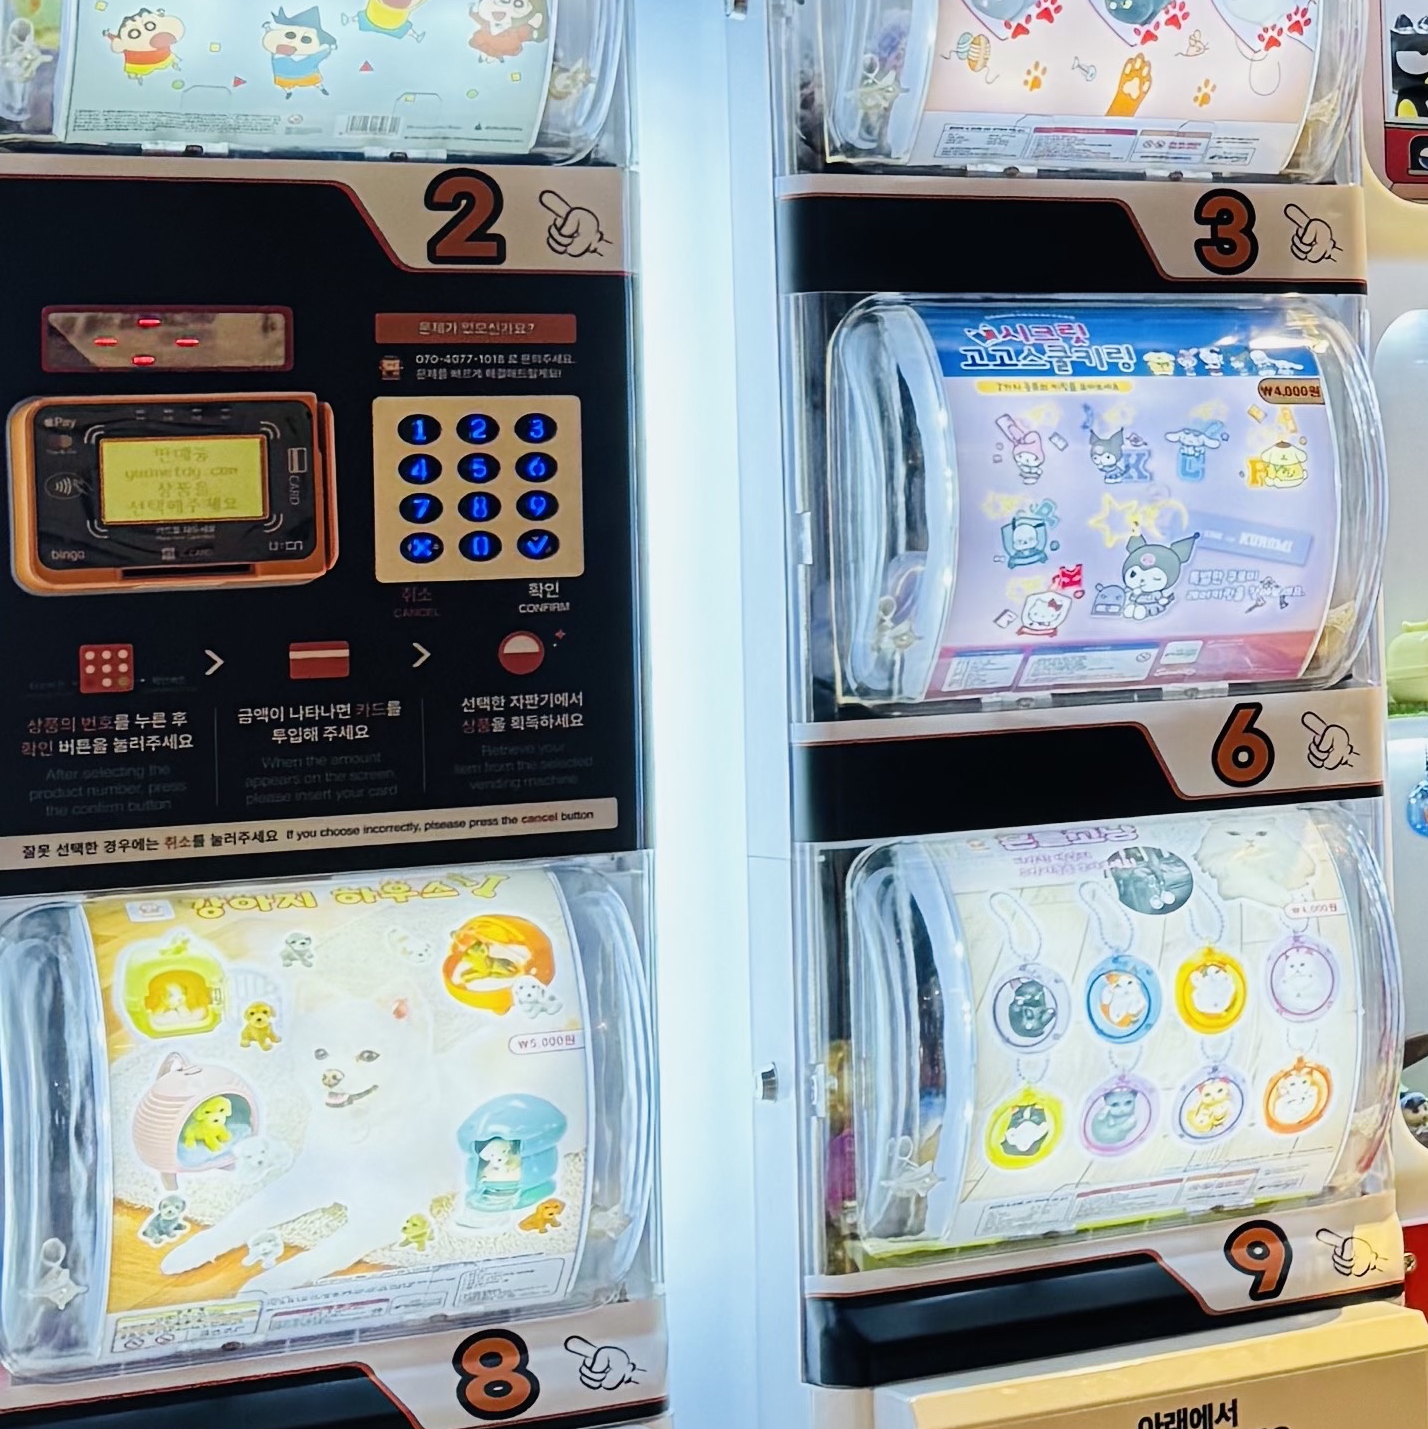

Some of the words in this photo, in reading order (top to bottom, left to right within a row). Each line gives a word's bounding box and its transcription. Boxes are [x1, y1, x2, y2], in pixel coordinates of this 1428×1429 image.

[424, 168, 507, 266] 2
[1194, 188, 1260, 276] 3
[1001, 321, 1091, 347] 시크릿
[958, 343, 1137, 375] 고고스쿨키링
[411, 419, 427, 441] 1
[470, 418, 487, 439] 2
[529, 419, 545, 439] 3
[410, 458, 428, 481] 4
[472, 458, 487, 478] 5
[528, 456, 546, 477] 6
[413, 498, 431, 519] 7
[472, 495, 489, 518] 8
[529, 495, 547, 517] 9
[472, 536, 490, 556] 0
[527, 581, 560, 599] 확인
[518, 601, 571, 614] CONFIRM
[237, 705, 285, 725] 금액이
[288, 702, 352, 722] 나타나면
[355, 700, 402, 719] 카드를
[461, 694, 506, 713] 선택한
[509, 691, 584, 710] 자판기에서
[134, 710, 167, 729] 누른
[171, 710, 188, 727] 후
[509, 712, 585, 731] 획득하세요
[58, 737, 109, 756] 버튼을
[113, 733, 195, 754] 눌러주세요
[271, 725, 320, 744] 투입해
[322, 724, 370, 742] 주세요
[1212, 701, 1276, 789] 6
[22, 844, 52, 860] 잘못
[55, 840, 99, 857] 선택한
[102, 837, 160, 854] 경우에는
[163, 834, 206, 851] 취소를
[210, 830, 279, 847] 눌러주세요
[295, 829, 318, 843] you
[319, 826, 361, 838] choose
[501, 815, 519, 826] the
[521, 812, 559, 824] cancel
[560, 809, 595, 822] button
[191, 891, 319, 919] 강아지
[332, 878, 461, 906] 하우스
[1223, 1219, 1293, 1301] 9
[451, 1328, 541, 1421] 8
